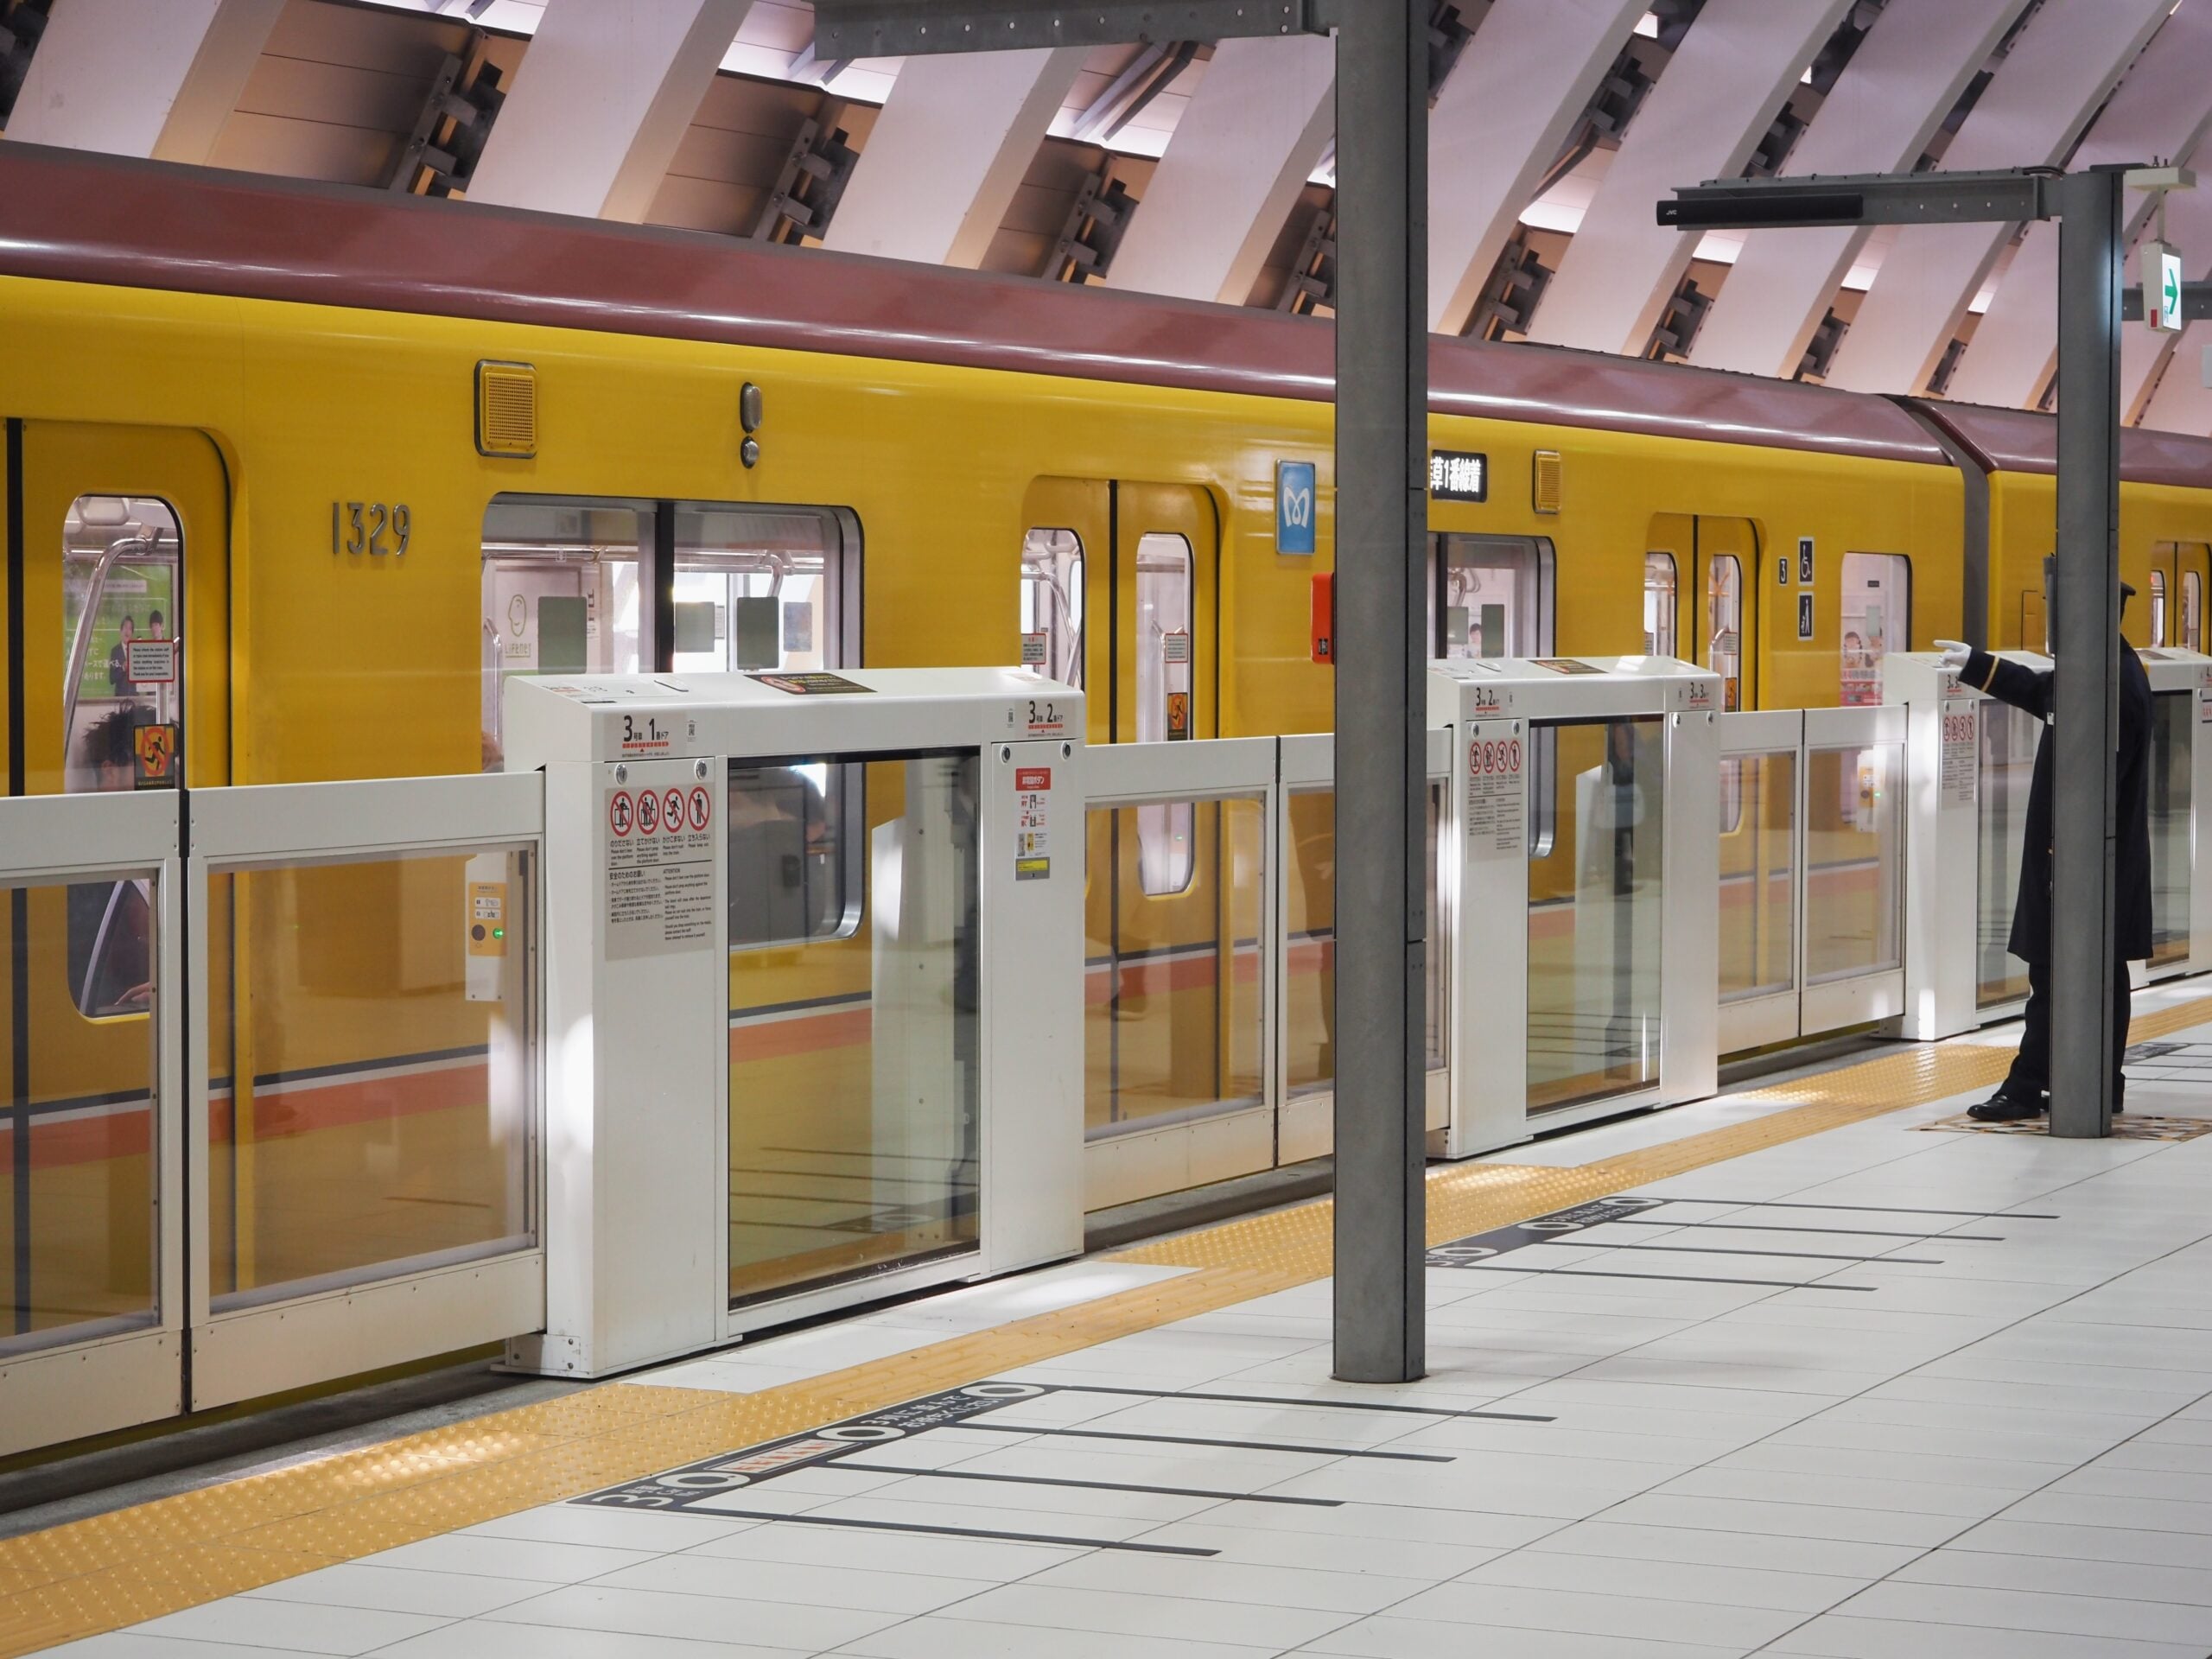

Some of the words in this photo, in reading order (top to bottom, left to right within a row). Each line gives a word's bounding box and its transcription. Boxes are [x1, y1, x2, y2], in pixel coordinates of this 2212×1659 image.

[332, 502, 410, 556] 1329
[1780, 560, 1786, 582] 3
[860, 1394, 971, 1426] 3列に並んで
[897, 1397, 1005, 1428] お待ちください
